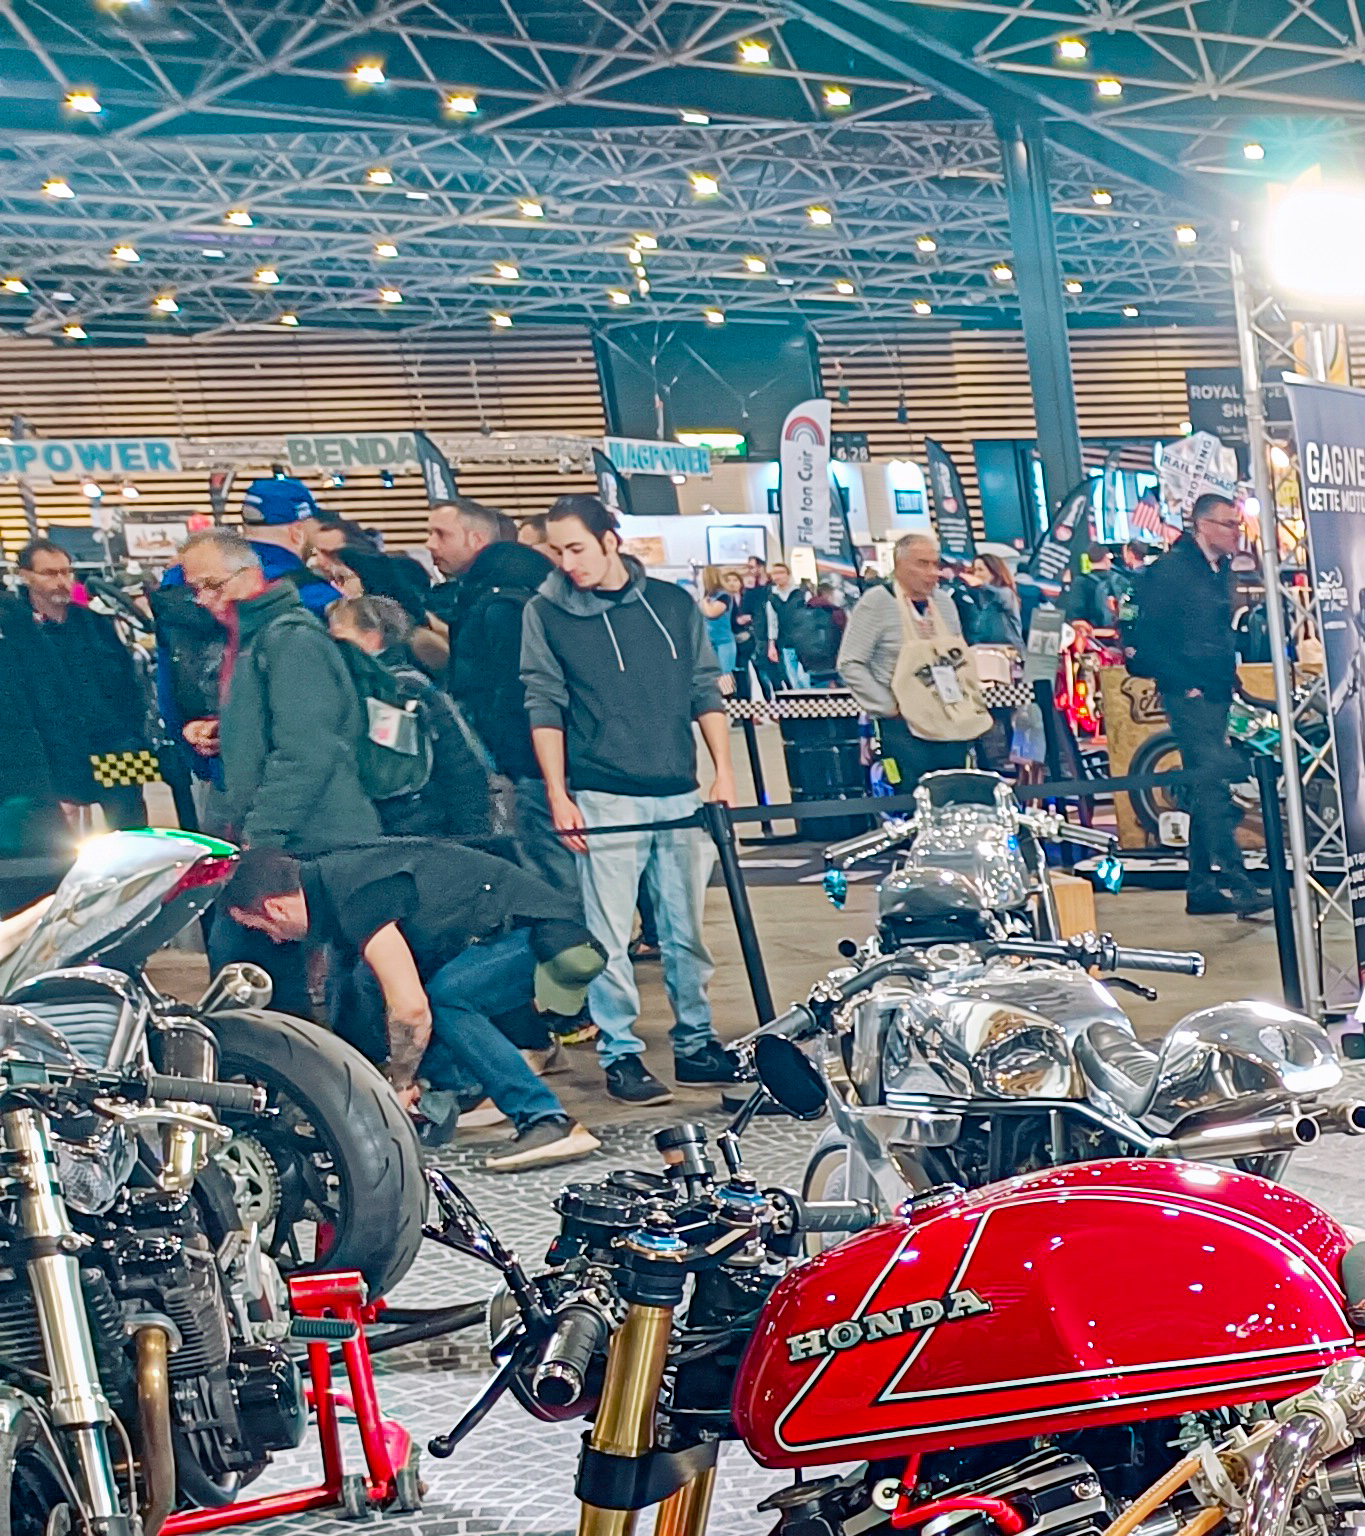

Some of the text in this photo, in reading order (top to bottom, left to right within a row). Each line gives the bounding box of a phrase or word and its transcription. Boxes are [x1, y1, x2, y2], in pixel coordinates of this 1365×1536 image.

[1190, 385, 1241, 400] ROYAL
[0, 442, 178, 473] POWER
[287, 436, 420, 468] BENDA
[607, 441, 712, 474] MAGPOWER
[796, 450, 815, 482] Cuir
[1162, 454, 1236, 492] RAIL ROAD
[1308, 487, 1341, 513] CETTE
[797, 516, 815, 544] File
[785, 1287, 994, 1363] HONDA
